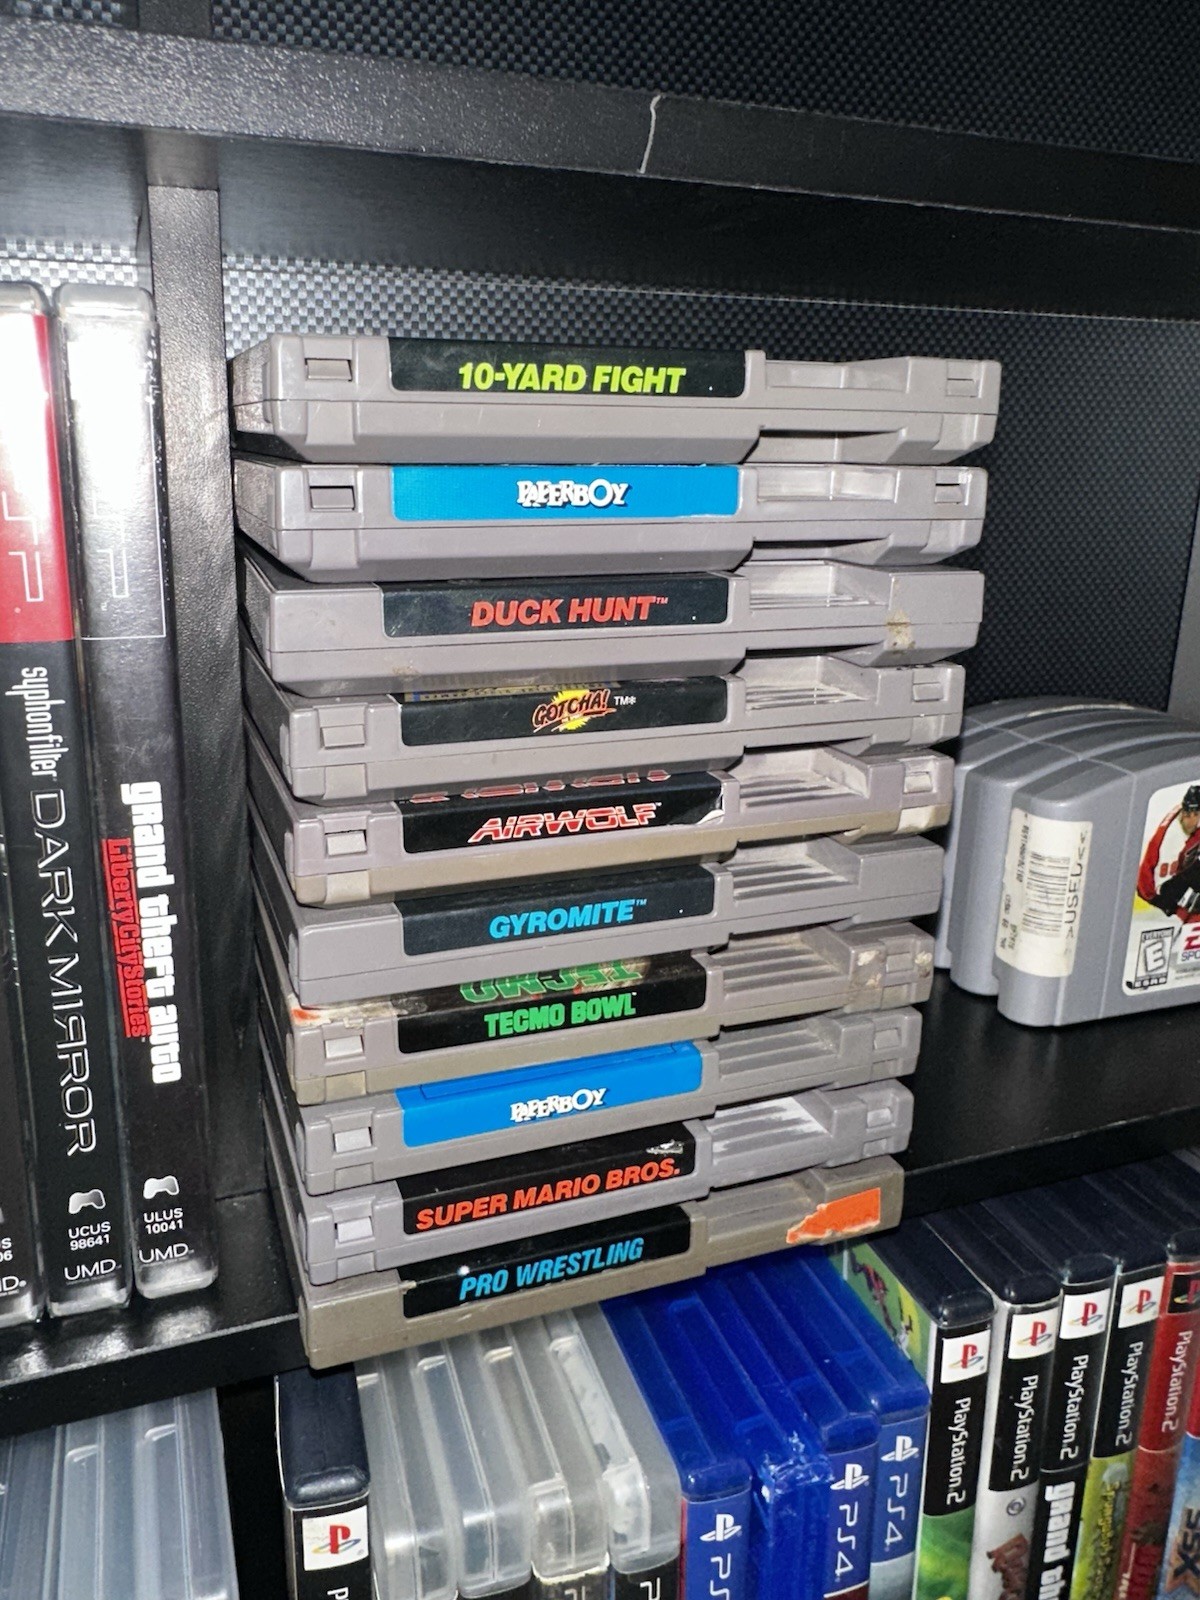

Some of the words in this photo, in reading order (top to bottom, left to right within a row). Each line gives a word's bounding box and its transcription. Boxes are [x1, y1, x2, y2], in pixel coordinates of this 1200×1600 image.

[458, 362, 587, 391] 10-YARD
[592, 365, 687, 394] FIGHT
[516, 478, 630, 508] PAPERBOY
[471, 599, 564, 627] DUCK
[532, 689, 613, 731] GOTCHA!
[30, 788, 78, 948] DARK
[484, 1003, 566, 1038] TECMO
[570, 993, 638, 1024] BOWL
[149, 1003, 182, 1084] auto
[509, 1087, 607, 1123] PAPERBOY
[415, 1194, 507, 1230] SUPER
[512, 1174, 600, 1213] MARIO
[605, 1158, 681, 1189] BROS.
[68, 1221, 112, 1240] UCUS
[143, 1207, 184, 1224] ULUS
[145, 1218, 184, 1235] 10041
[69, 1233, 110, 1251] 98641
[138, 1243, 190, 1264] UMD
[63, 1259, 118, 1281] UMD
[459, 1271, 508, 1301] PRO
[516, 1237, 645, 1280] WRESTLING
[886, 1472, 909, 1546] PS4
[835, 1501, 859, 1576] PS4
[709, 1553, 732, 1600] PS
